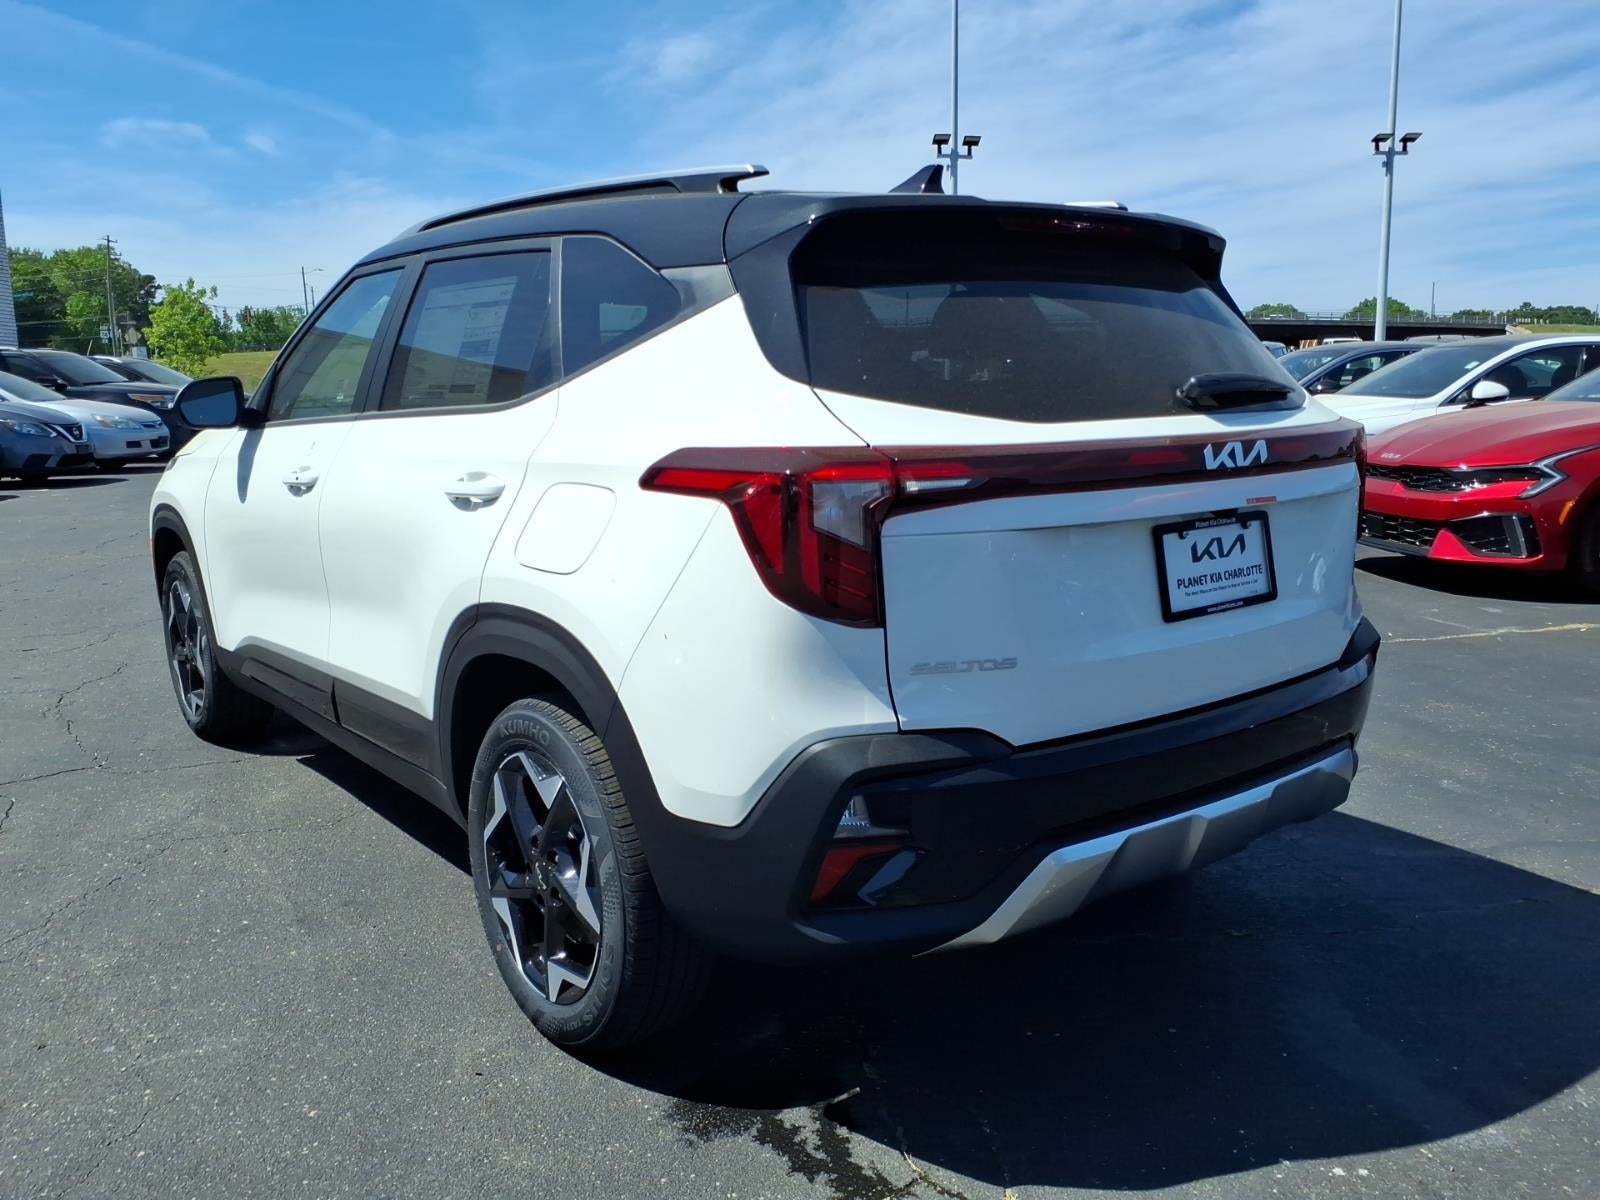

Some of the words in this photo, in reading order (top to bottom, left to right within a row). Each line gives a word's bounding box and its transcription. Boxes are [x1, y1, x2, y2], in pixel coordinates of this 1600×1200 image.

[1203, 439, 1268, 470] KIA
[1190, 533, 1246, 563] KIA
[1177, 574, 1208, 590] PLANET
[1209, 571, 1223, 583] KIA
[1223, 564, 1263, 580] CHARLOTTE
[910, 657, 1018, 676] SELTOS
[500, 719, 550, 747] KUMHO
